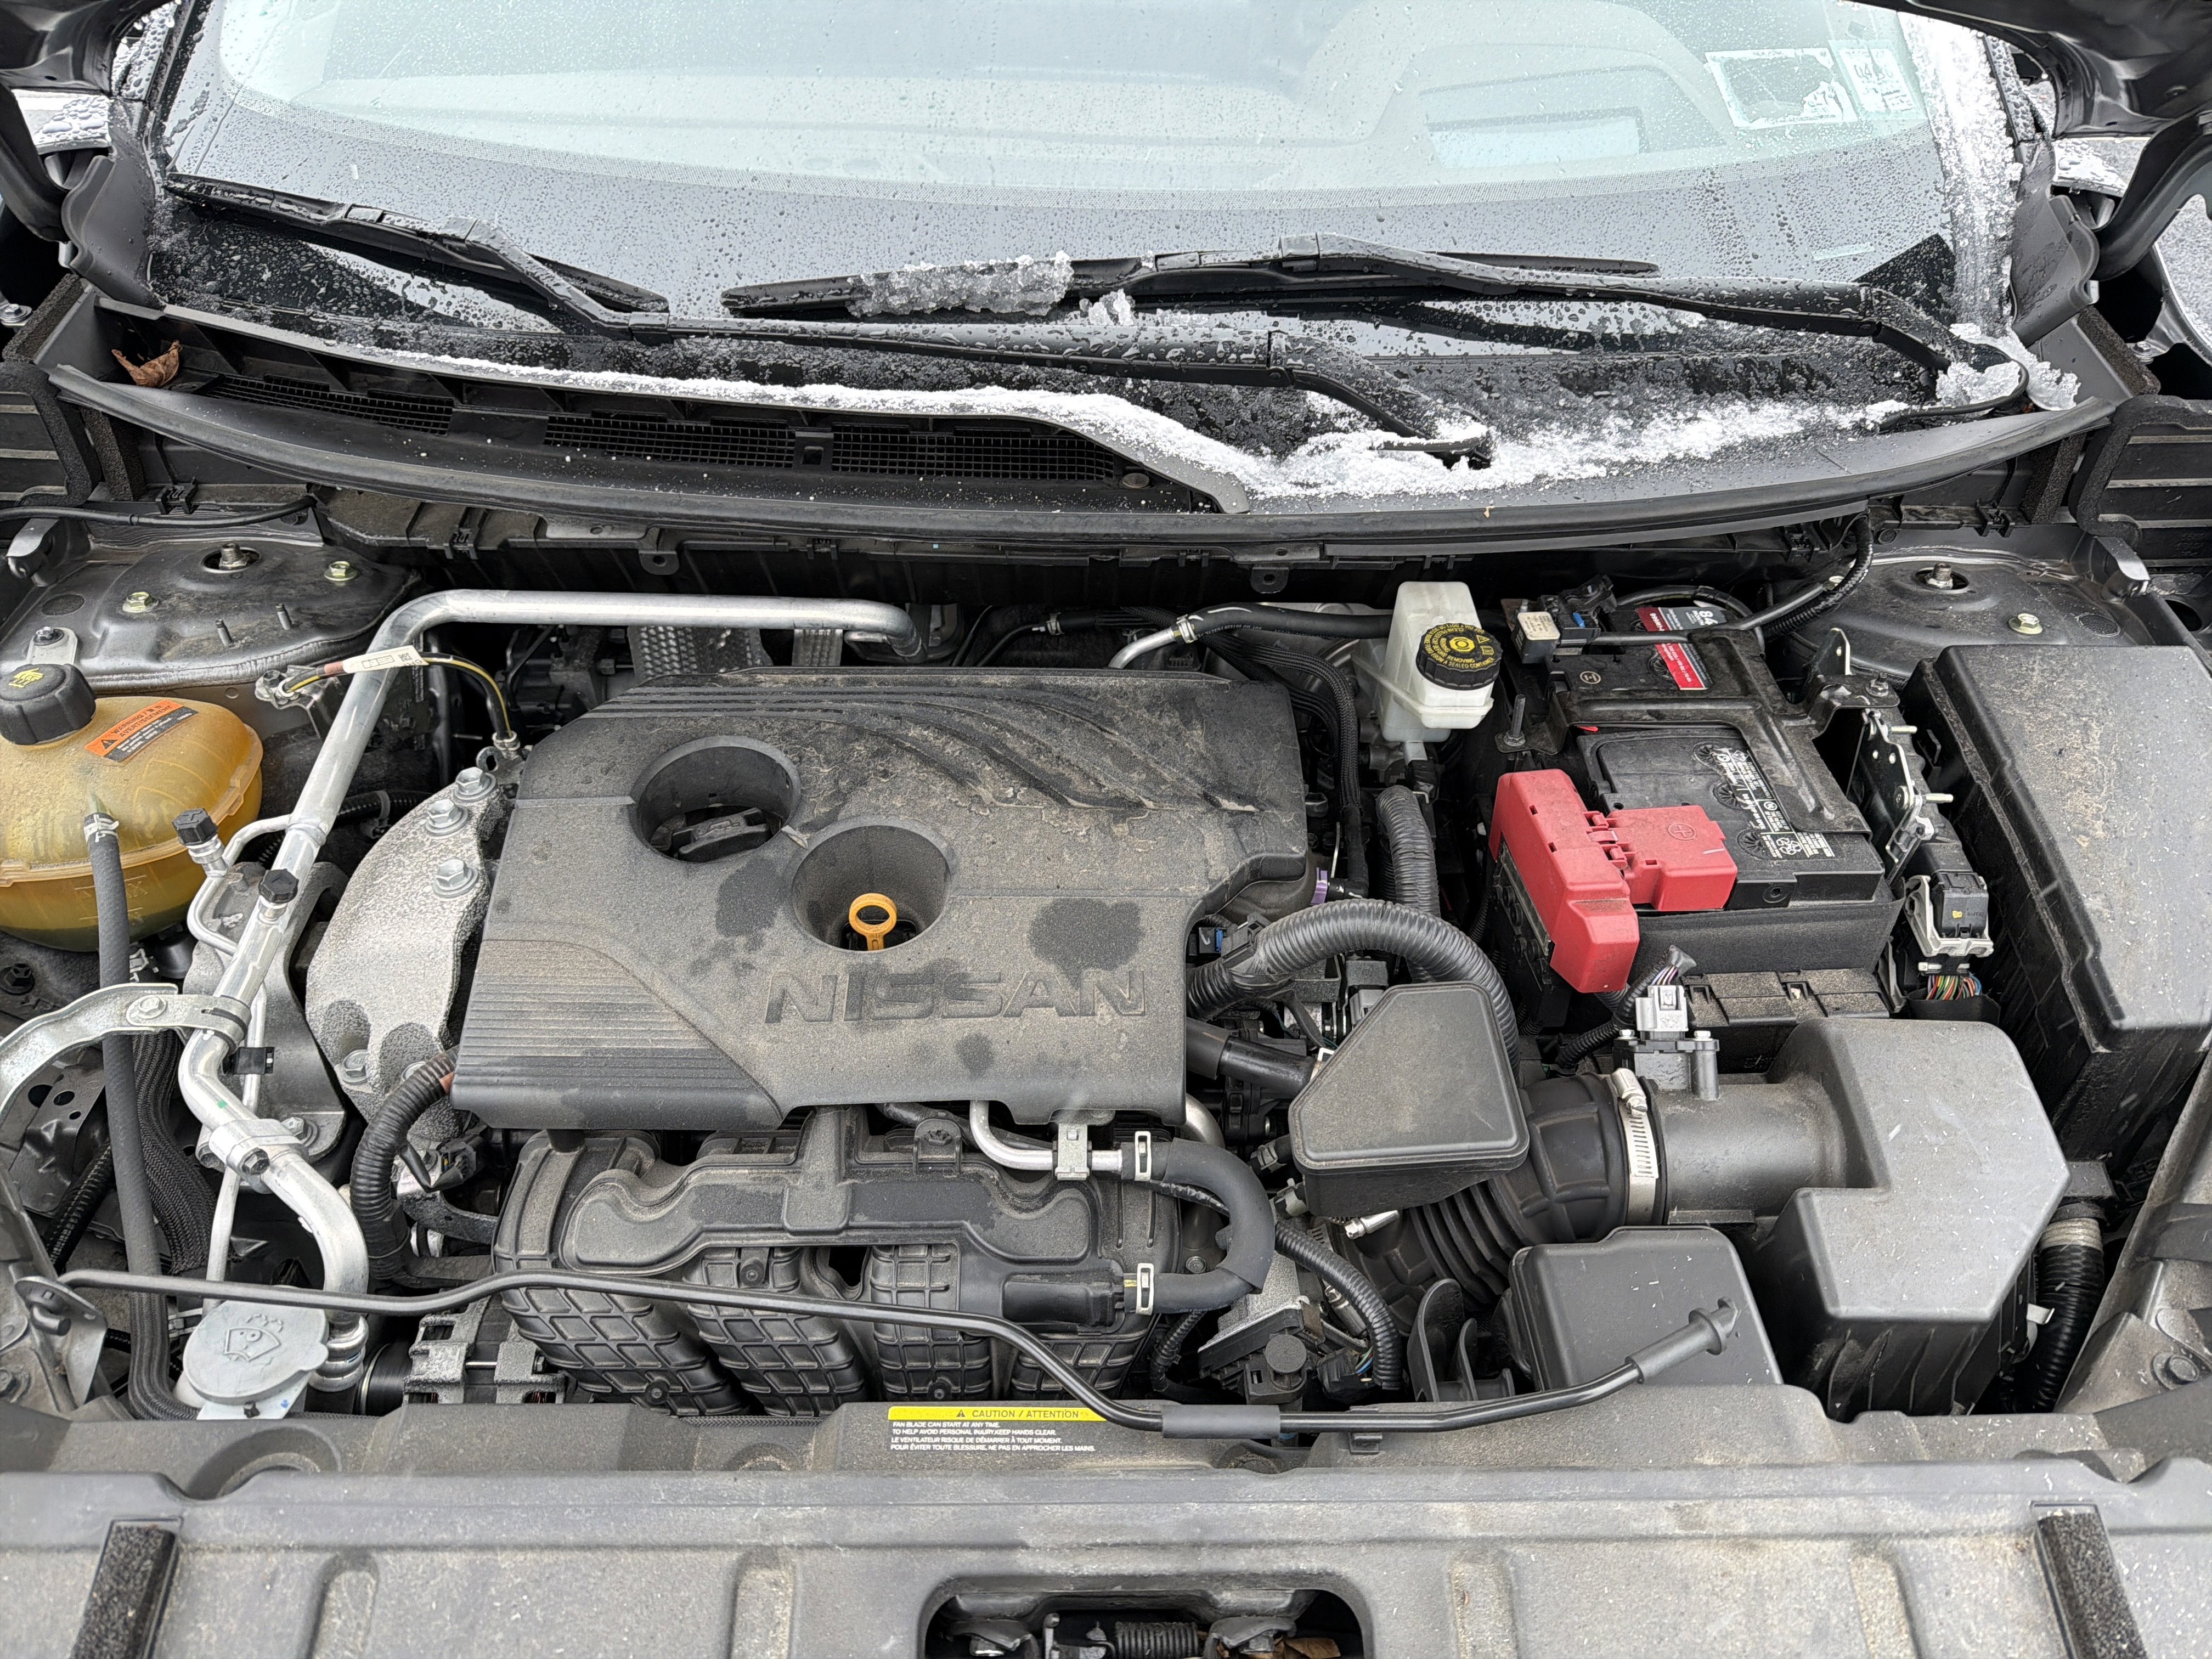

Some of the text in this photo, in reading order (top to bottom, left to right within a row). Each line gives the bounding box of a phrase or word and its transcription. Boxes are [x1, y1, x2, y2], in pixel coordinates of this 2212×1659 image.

[1699, 610, 1719, 625] 84
[1431, 653, 1444, 663] FROM
[1470, 657, 1494, 668] CONTAINER
[1432, 644, 1448, 657] BEFORE
[1447, 654, 1475, 663] REMOVING
[120, 705, 173, 738] AVERTISSEMENT
[765, 970, 1146, 1024] NISSAN
